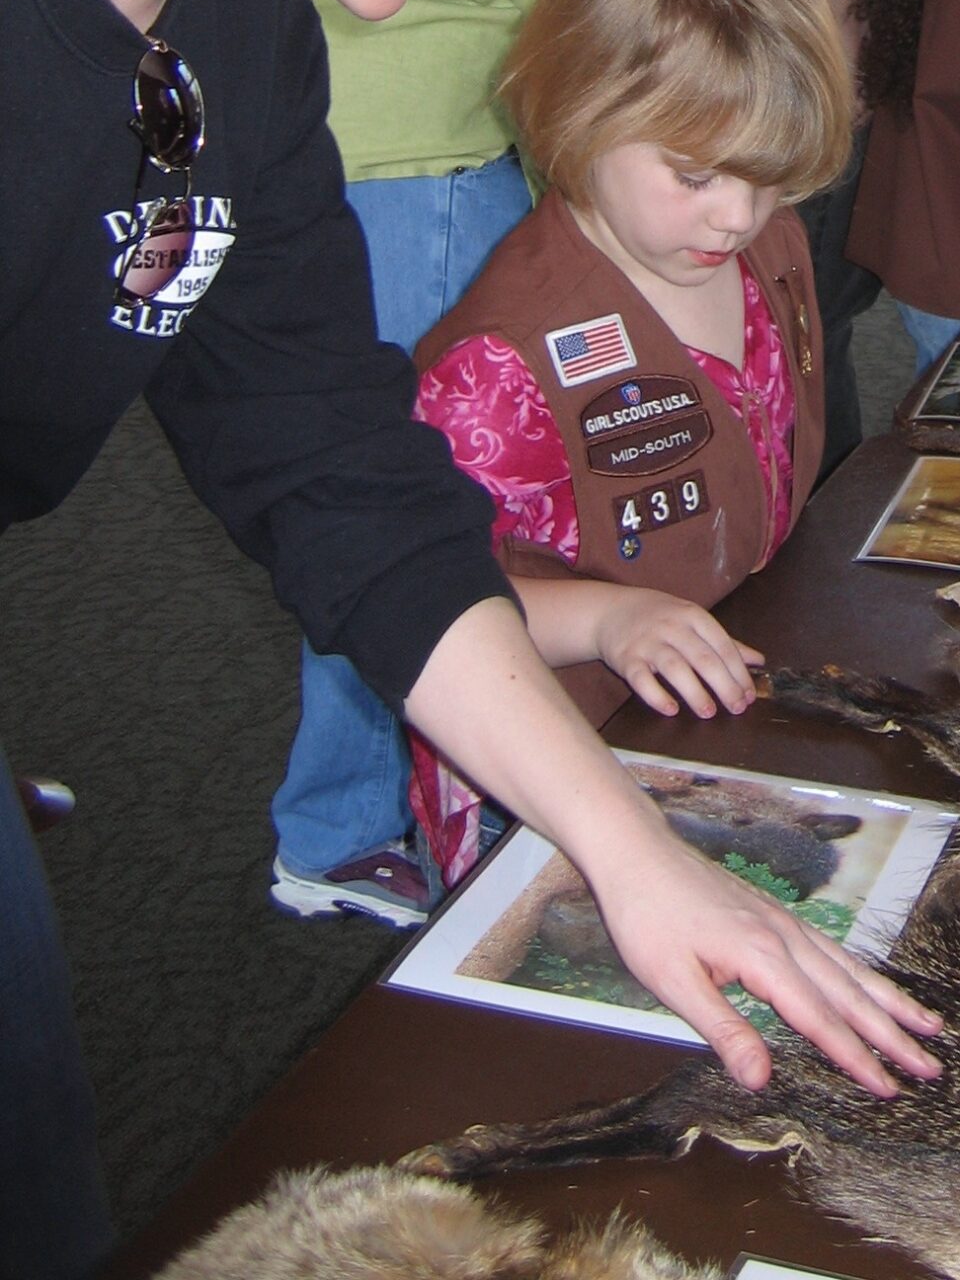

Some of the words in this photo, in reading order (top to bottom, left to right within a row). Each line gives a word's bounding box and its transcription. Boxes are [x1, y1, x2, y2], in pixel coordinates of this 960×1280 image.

[585, 414, 615, 434] GIRL
[614, 400, 663, 426] SCOUTS
[610, 430, 693, 465] MID-SOUTH
